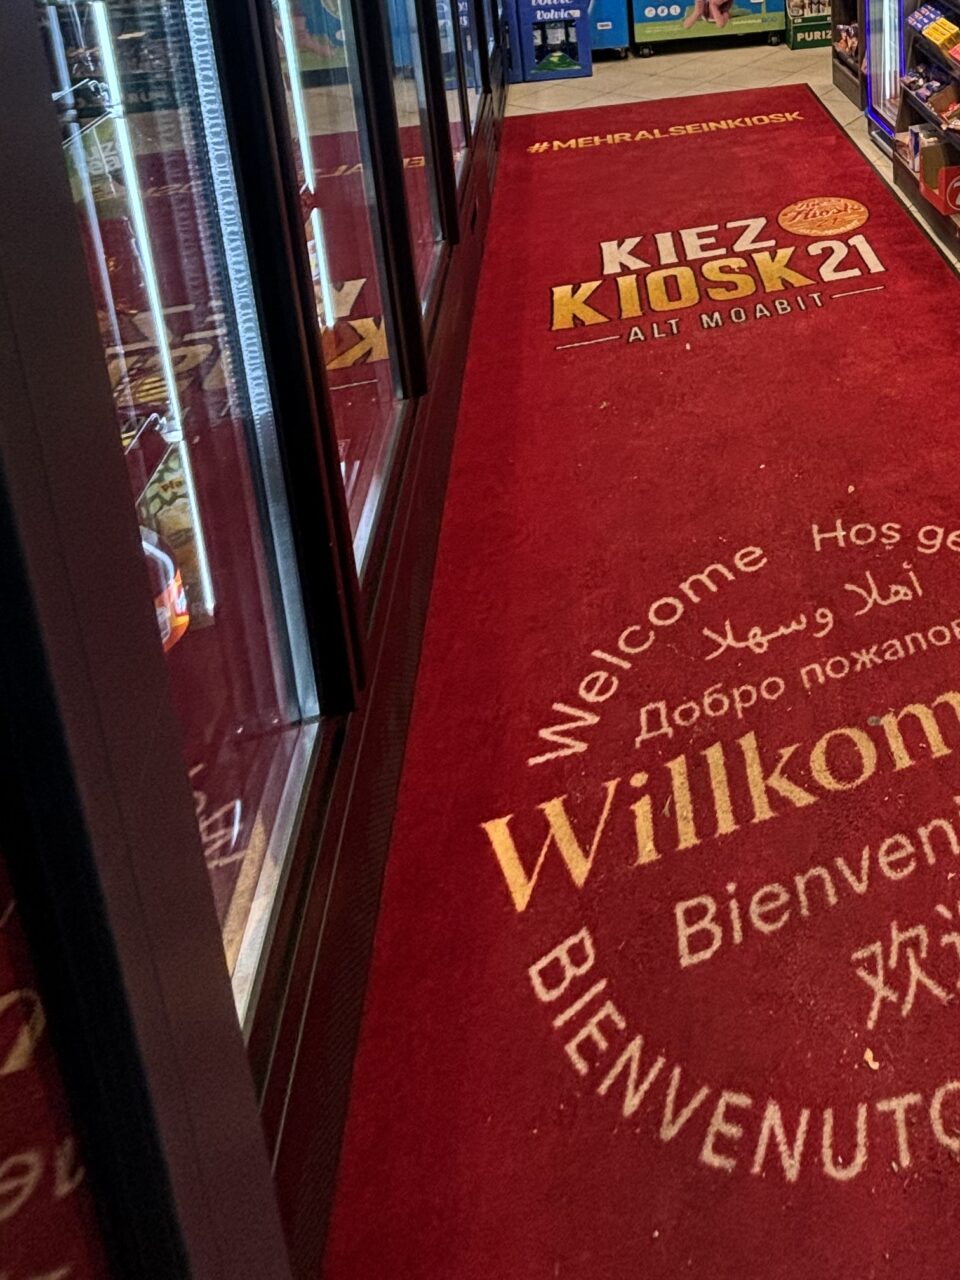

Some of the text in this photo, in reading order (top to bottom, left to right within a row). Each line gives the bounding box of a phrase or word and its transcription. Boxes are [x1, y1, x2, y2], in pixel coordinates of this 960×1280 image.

[526, 111, 805, 154] #MEHRALSEINKIOSK
[599, 216, 778, 276] KIEZ
[550, 234, 887, 331] KIOSK 21
[628, 292, 825, 343] ALT MOABIT
[812, 519, 901, 552] Hoş
[527, 545, 768, 767] Welcome
[634, 675, 785, 749] Добро
